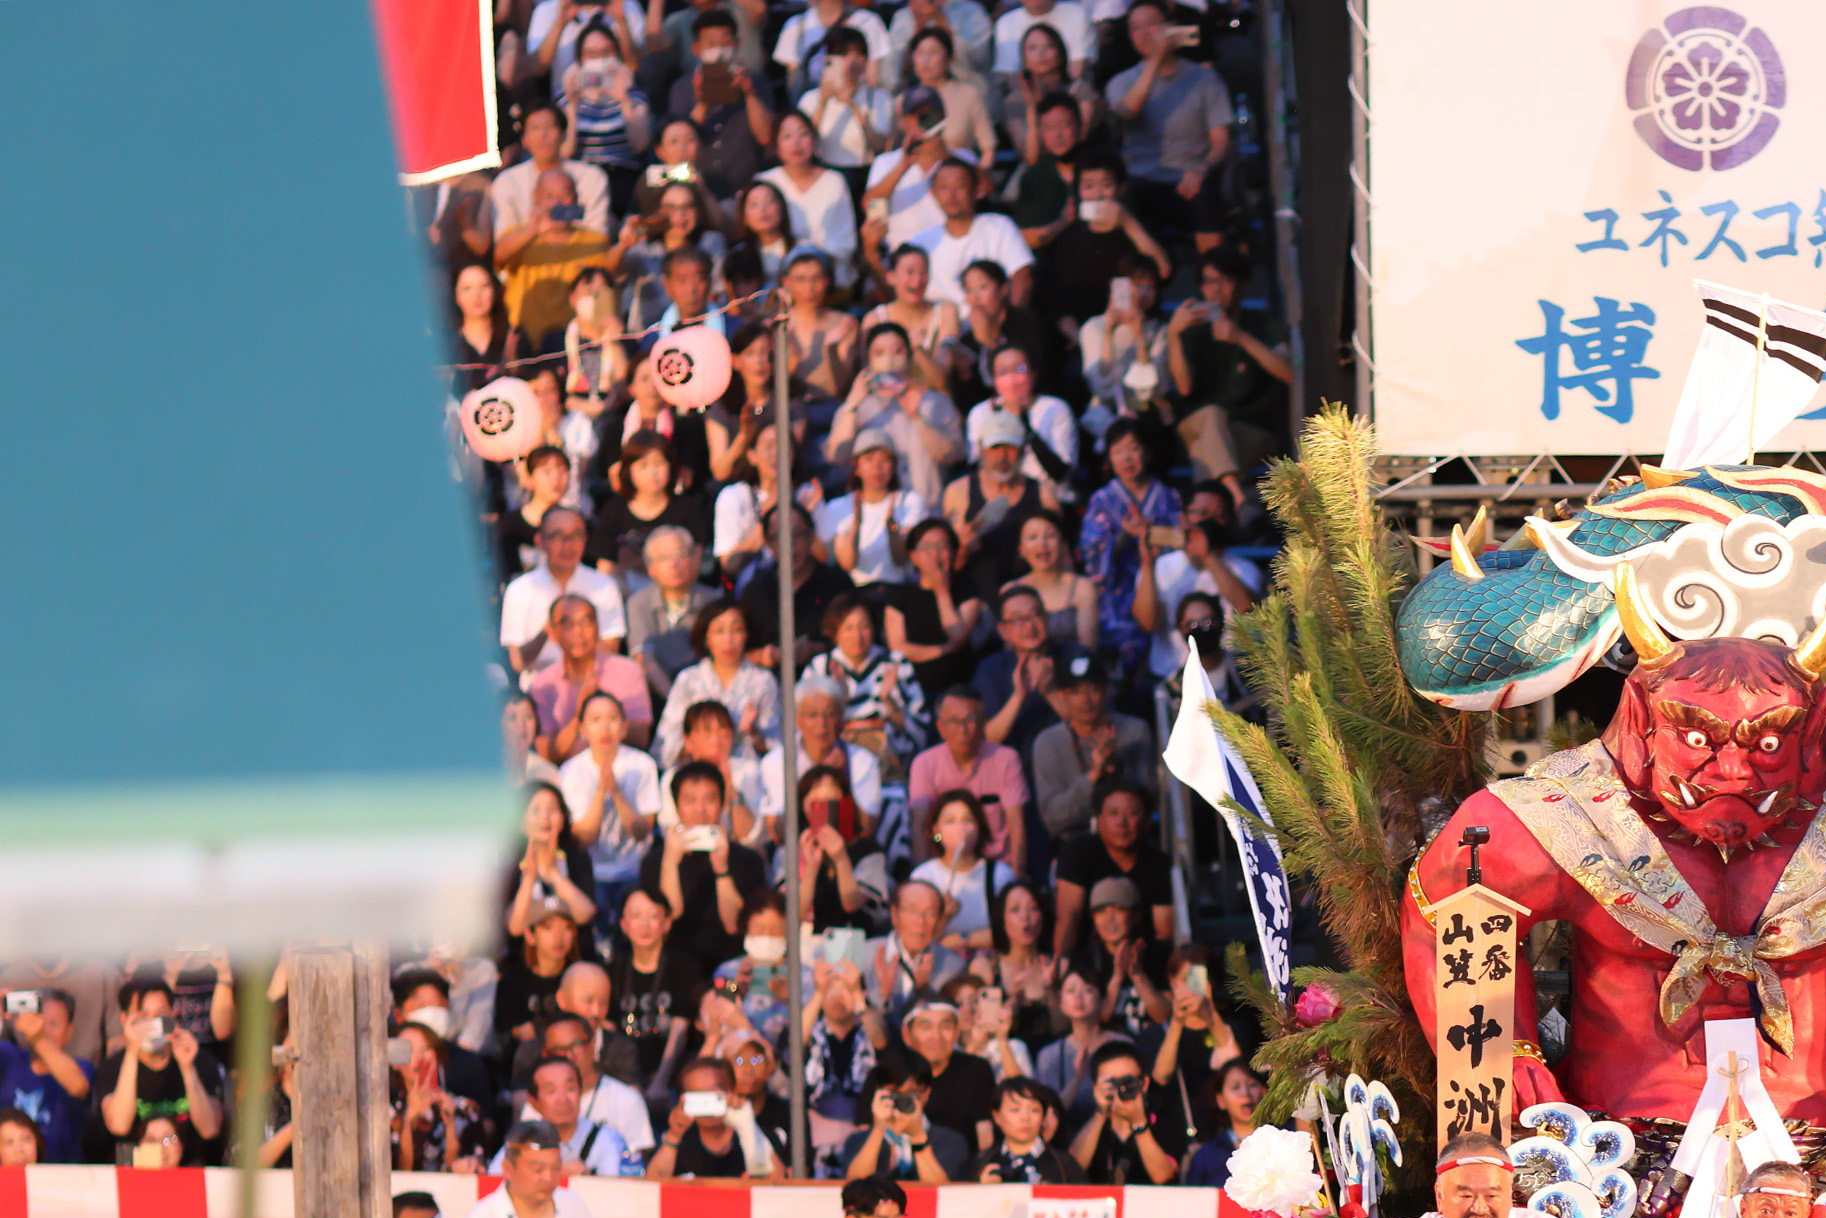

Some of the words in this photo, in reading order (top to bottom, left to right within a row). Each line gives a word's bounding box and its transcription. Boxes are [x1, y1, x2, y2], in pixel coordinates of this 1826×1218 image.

[1443, 913, 1476, 989] 山笠
[1478, 914, 1512, 981] 四番
[1444, 1005, 1506, 1145] 中洲
